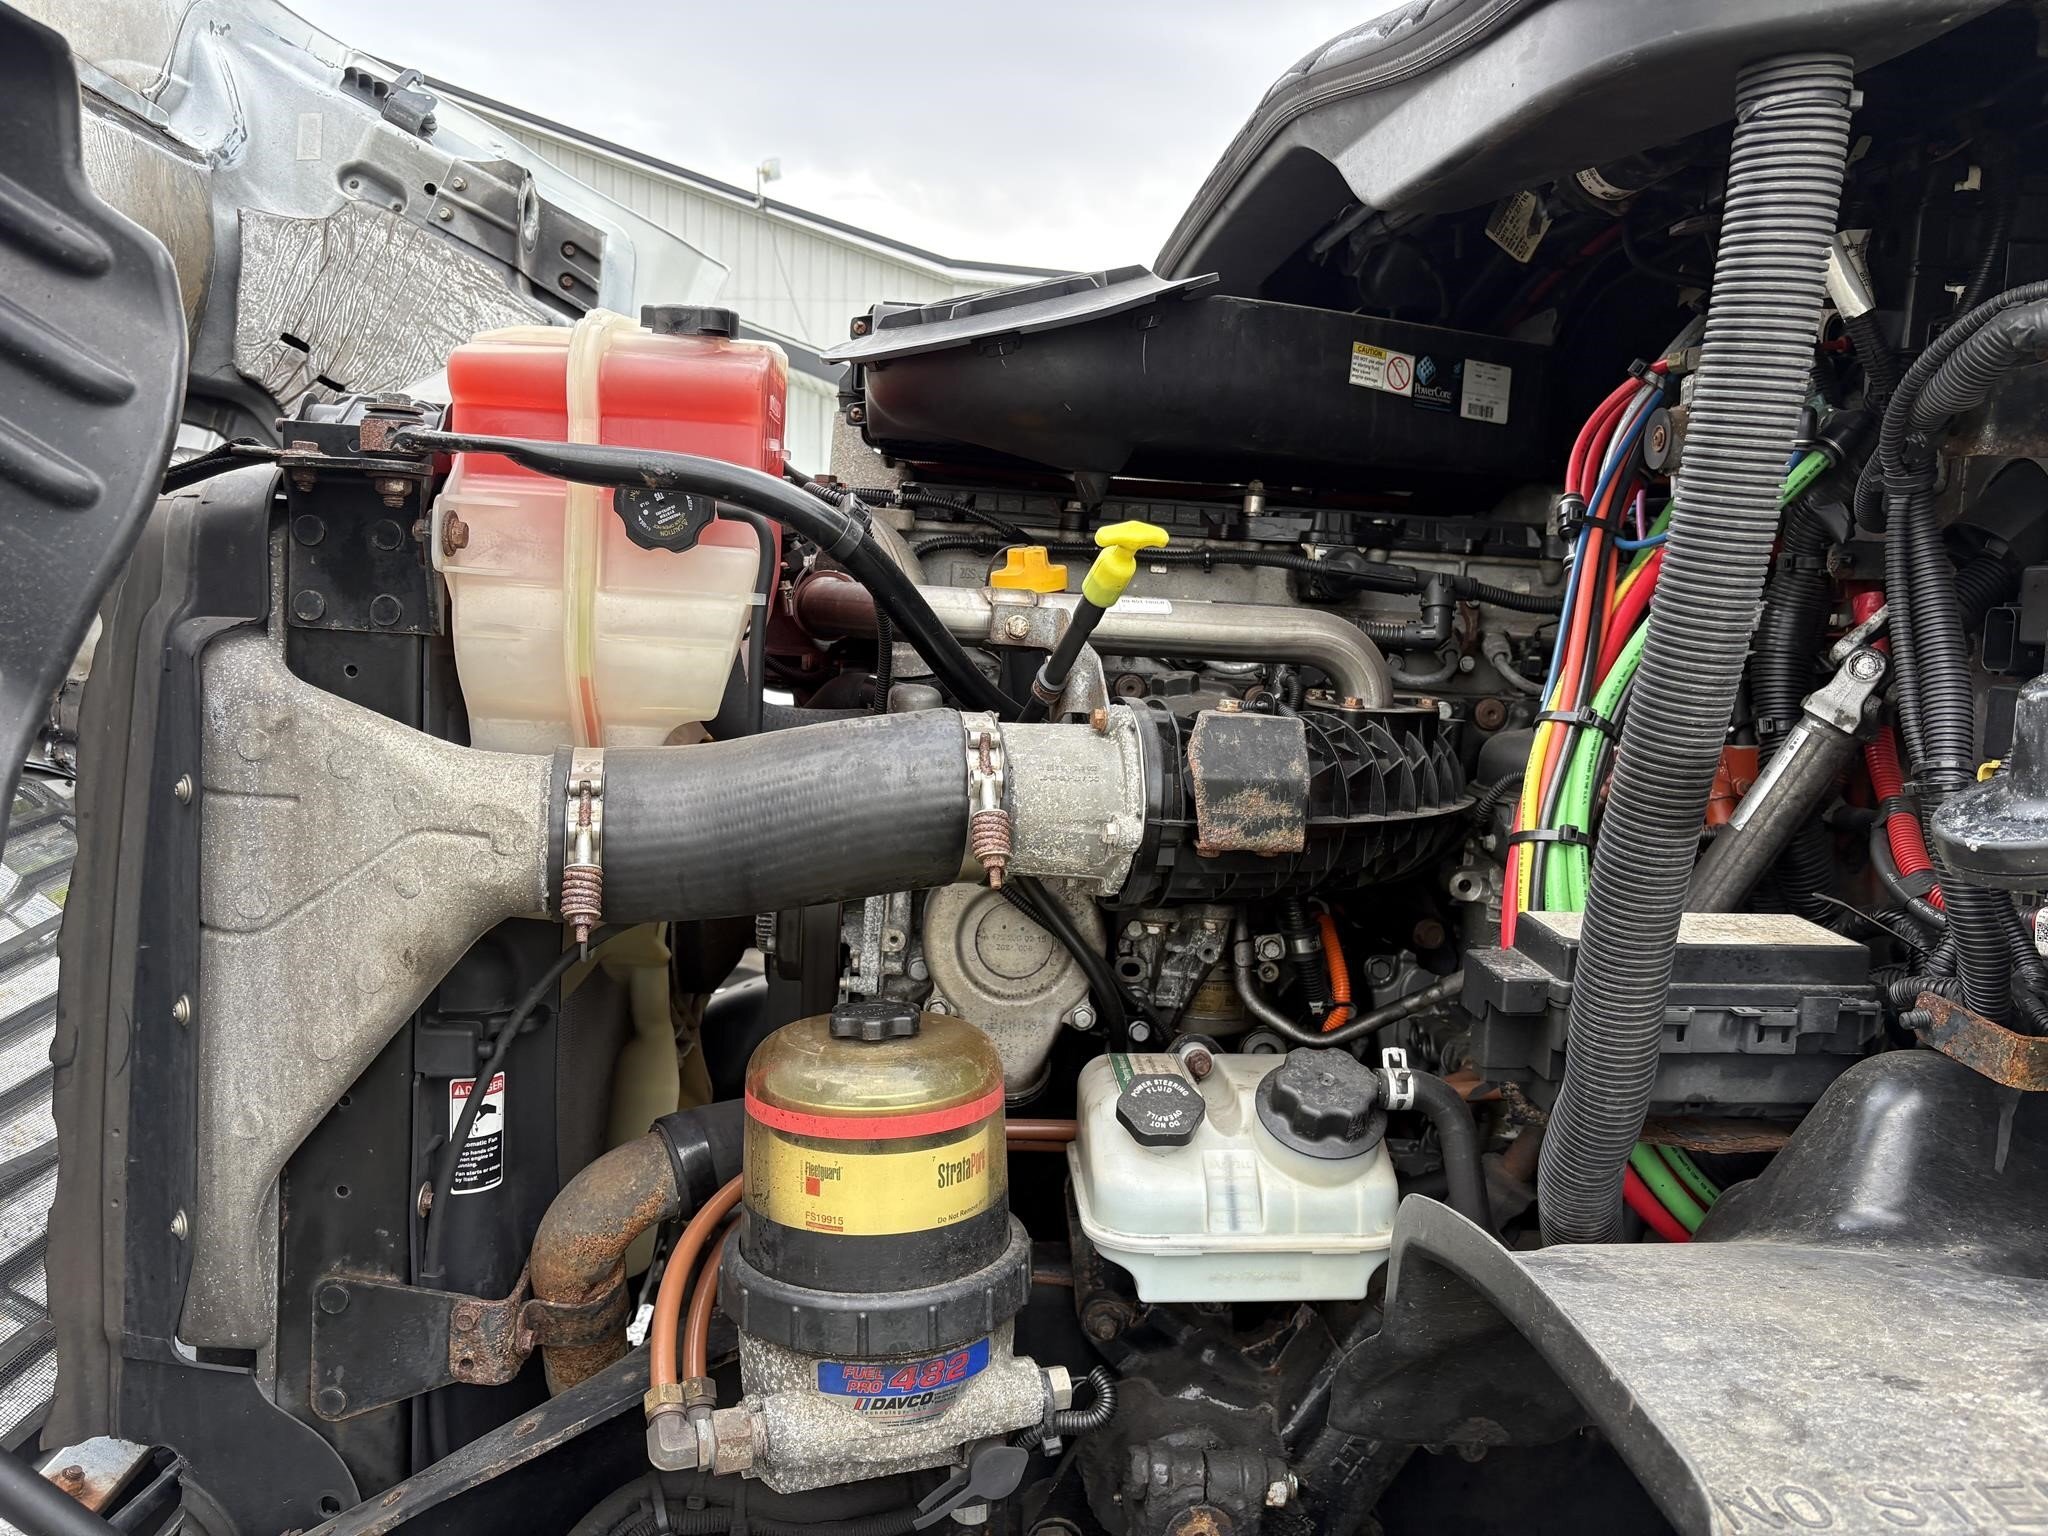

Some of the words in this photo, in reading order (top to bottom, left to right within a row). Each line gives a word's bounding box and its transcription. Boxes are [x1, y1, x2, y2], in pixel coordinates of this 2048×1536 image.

[1357, 345, 1383, 357] CAUTION
[660, 523, 684, 537] CAUTION
[465, 1079, 503, 1095] DGER
[1130, 1080, 1152, 1098] POWER
[1153, 1079, 1189, 1097] STEERING
[1146, 1086, 1172, 1094] FLUID
[1146, 1109, 1183, 1121] OVERFILL
[1149, 1120, 1166, 1129] NOT
[1168, 1120, 1181, 1128] DO
[488, 1136, 498, 1144] Fan
[470, 1147, 487, 1155] hands
[471, 1154, 489, 1162] engine
[466, 1168, 482, 1176] starts
[805, 1161, 841, 1181] Fleetguard
[805, 1210, 844, 1226] FS19915
[937, 1216, 947, 1224] Do
[948, 1212, 959, 1222] Not
[843, 1366, 884, 1380] FUEL
[887, 1350, 970, 1393] 482
[846, 1379, 883, 1393] PRO
[1711, 1485, 1834, 1530] NO
